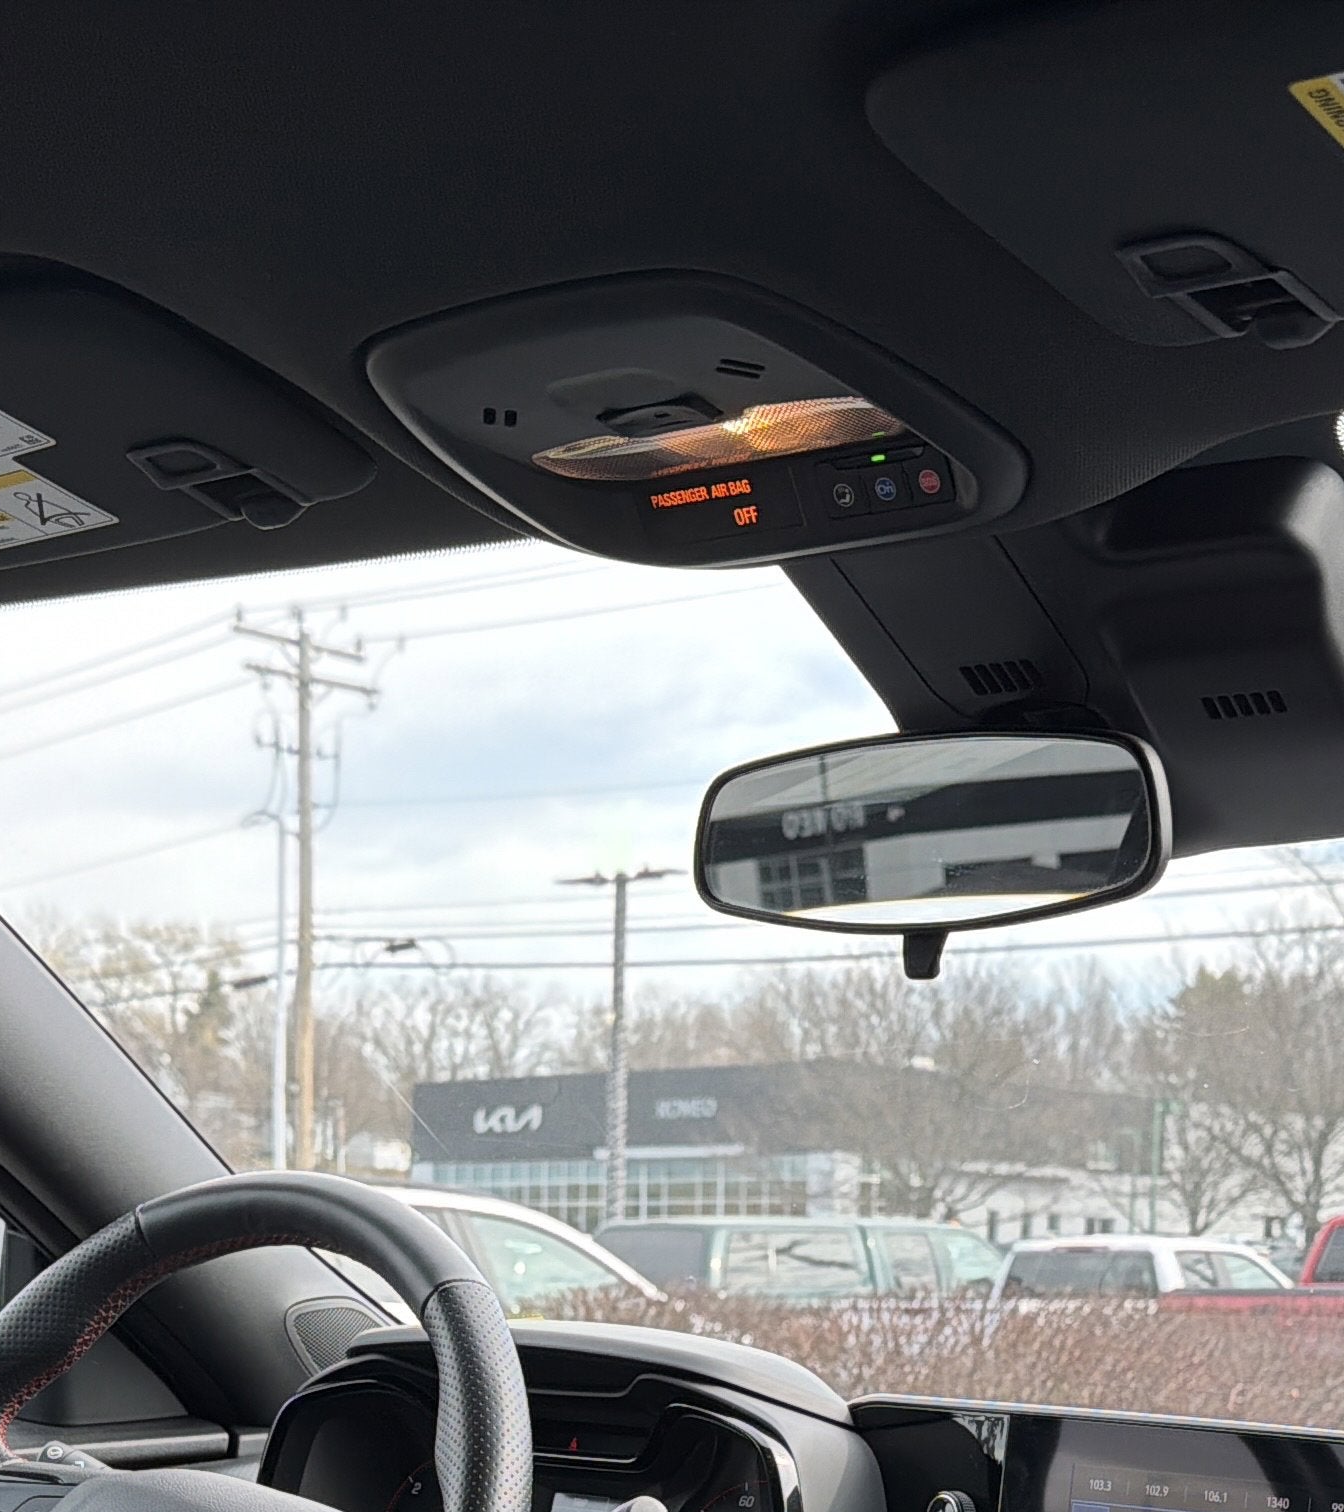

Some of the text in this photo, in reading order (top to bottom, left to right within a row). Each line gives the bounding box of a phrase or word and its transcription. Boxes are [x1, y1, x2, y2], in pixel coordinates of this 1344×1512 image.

[651, 479, 752, 509] PASSENGER AIR BAG
[733, 505, 758, 526] OFF
[411, 1482, 422, 1495] 2
[1088, 1478, 1112, 1492] 103.3
[1144, 1483, 1169, 1498] 102.9
[1203, 1489, 1228, 1503] 106.1
[1265, 1496, 1290, 1510] 1340
[738, 1495, 755, 1508] 60
